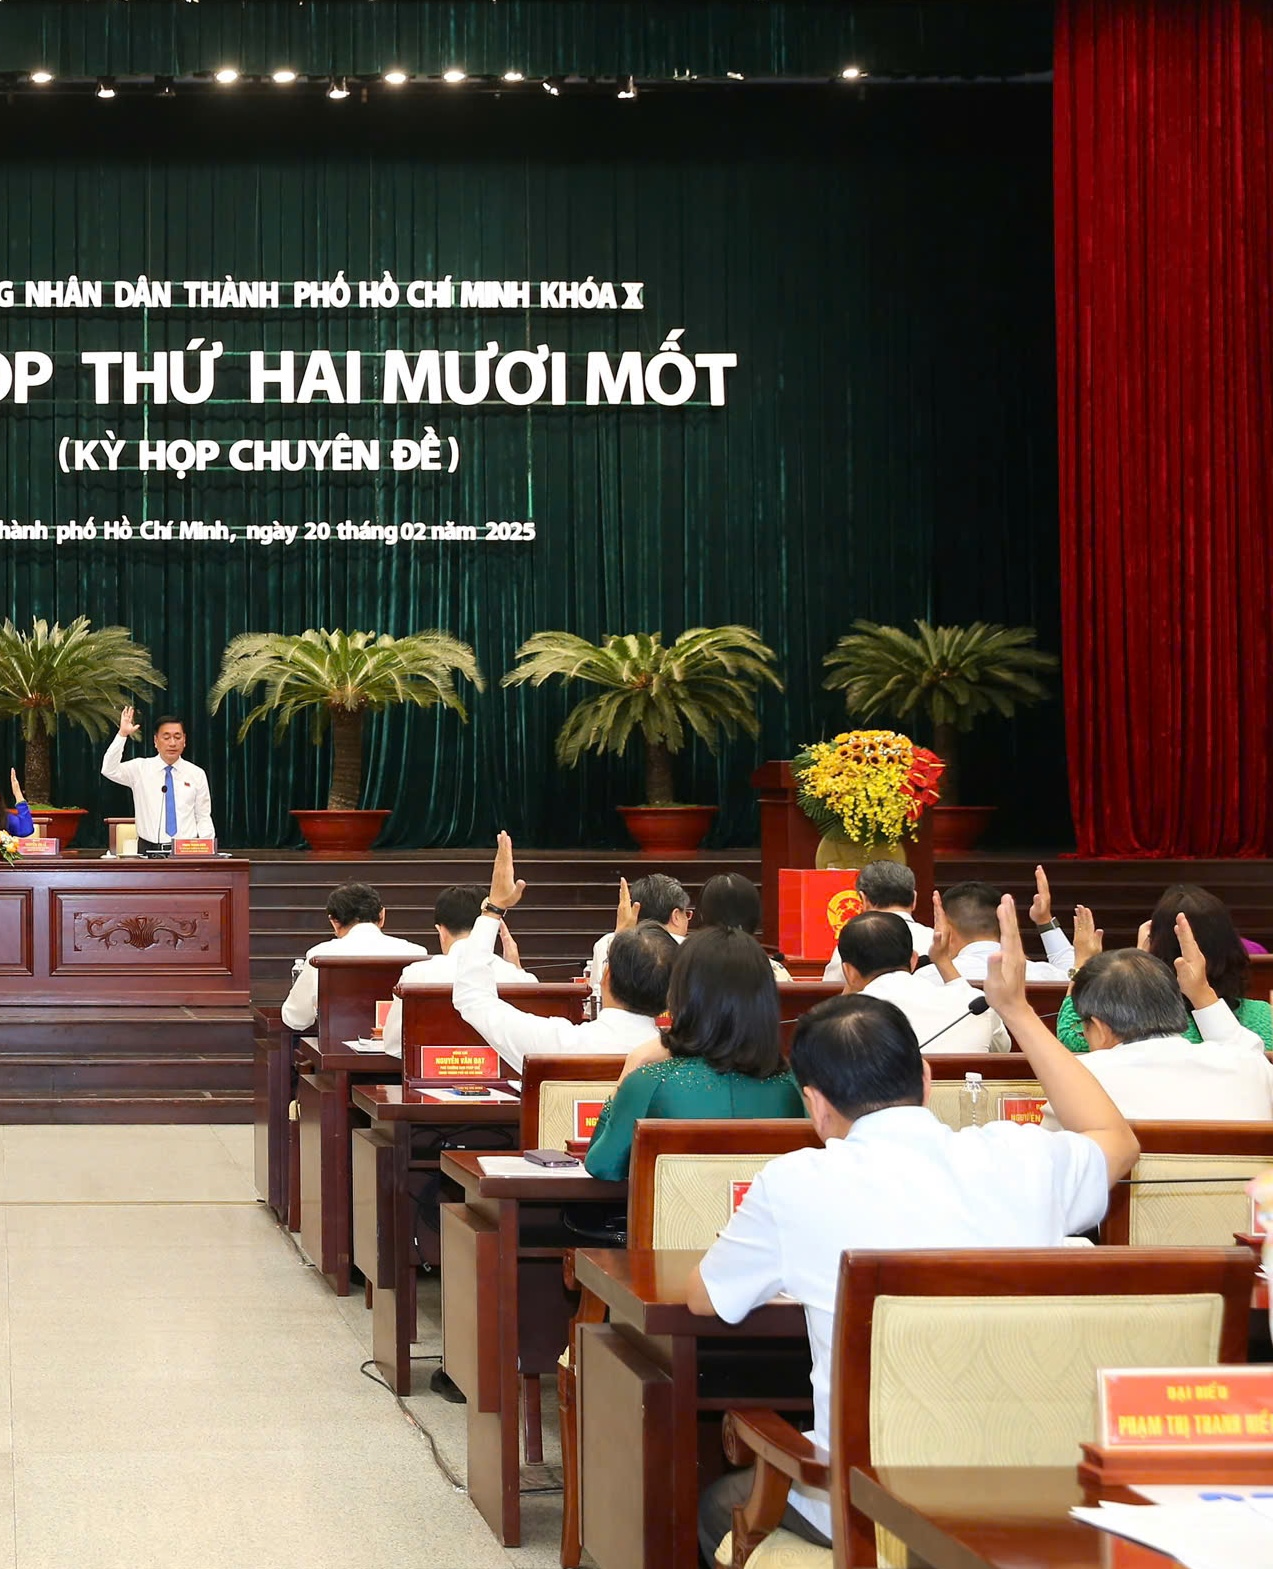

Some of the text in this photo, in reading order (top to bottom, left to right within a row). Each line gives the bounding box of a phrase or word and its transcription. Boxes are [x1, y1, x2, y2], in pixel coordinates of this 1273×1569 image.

[27, 275, 102, 309] NHÂN
[114, 275, 172, 309] DÂN
[183, 275, 279, 309] THÀNH
[293, 270, 351, 309] PHỐ
[358, 270, 400, 309] HỒ
[406, 275, 453, 309] CHÍ
[460, 281, 531, 309] MINH
[540, 275, 618, 310] KHÓA
[620, 282, 645, 310] X
[81, 337, 224, 405] THỨ
[249, 349, 362, 404] HAI
[382, 340, 567, 406] MƯƠI
[585, 328, 738, 406] MỐT
[58, 430, 127, 473] (KỲ
[138, 439, 221, 480] HỌP
[228, 432, 380, 472] CHUYÊN
[56, 516, 98, 545] phố
[103, 515, 133, 541] Hồ
[139, 520, 175, 541] Chí
[179, 520, 237, 544] Minh,
[245, 520, 299, 545] ngày
[303, 521, 332, 541] 20
[335, 519, 399, 546] tháng
[400, 521, 427, 541] 02
[430, 520, 478, 541] năm
[484, 521, 537, 541] 2025
[460, 1056, 473, 1065] VĂN
